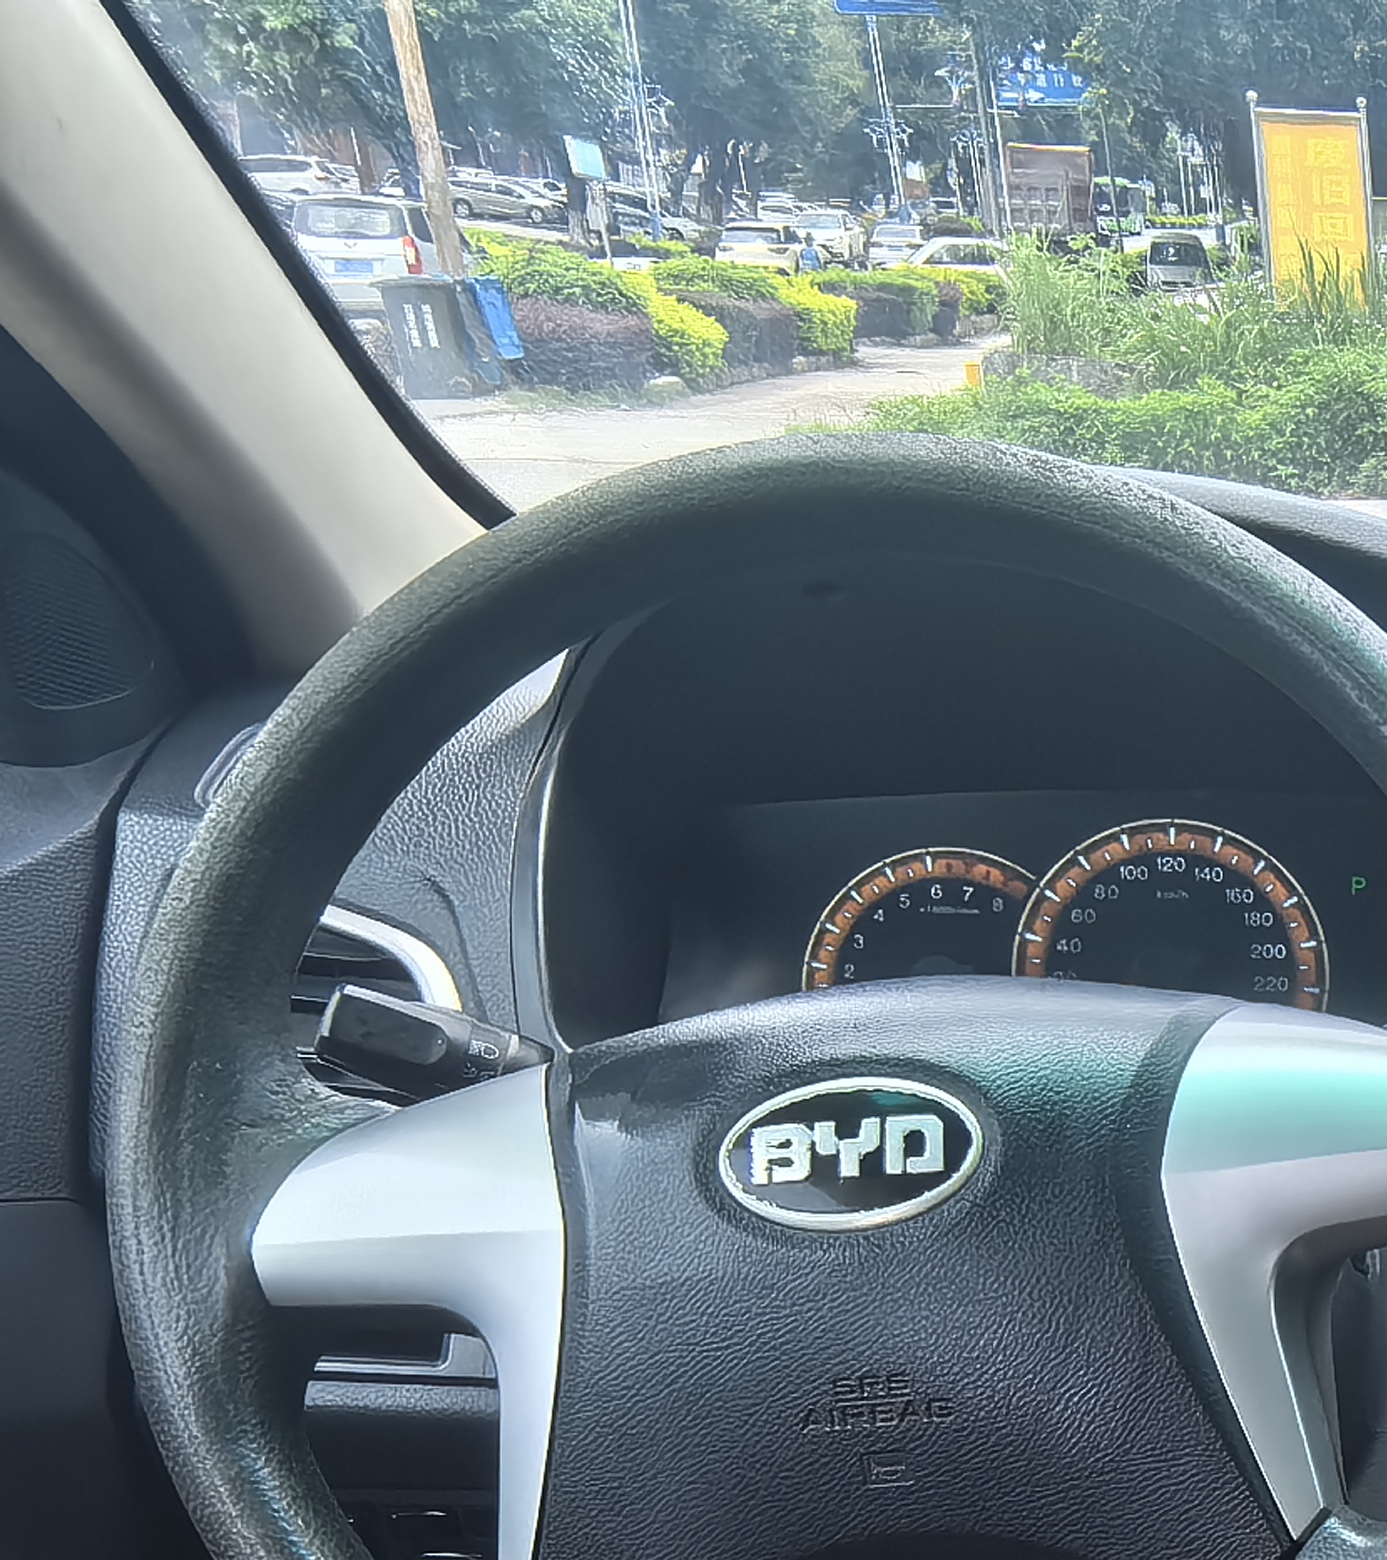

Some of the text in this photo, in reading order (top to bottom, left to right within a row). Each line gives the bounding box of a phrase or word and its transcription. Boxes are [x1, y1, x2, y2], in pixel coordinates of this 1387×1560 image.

[1156, 856, 1186, 872] 120
[1120, 865, 1148, 880] 100
[1195, 867, 1223, 882] 140
[930, 884, 942, 899] 6
[1094, 884, 1119, 900] 80
[1351, 876, 1366, 895] P
[899, 893, 910, 908] 5
[962, 885, 974, 902] 7
[1225, 887, 1254, 903] 160
[873, 909, 885, 922] 4
[1071, 908, 1096, 923] 60
[1244, 912, 1273, 927] 180
[853, 934, 864, 949] 3
[1056, 938, 1081, 953] 40
[1250, 944, 1287, 959] 200
[843, 963, 855, 980] 2
[1253, 976, 1289, 992] 220
[750, 1115, 945, 1186] BYD
